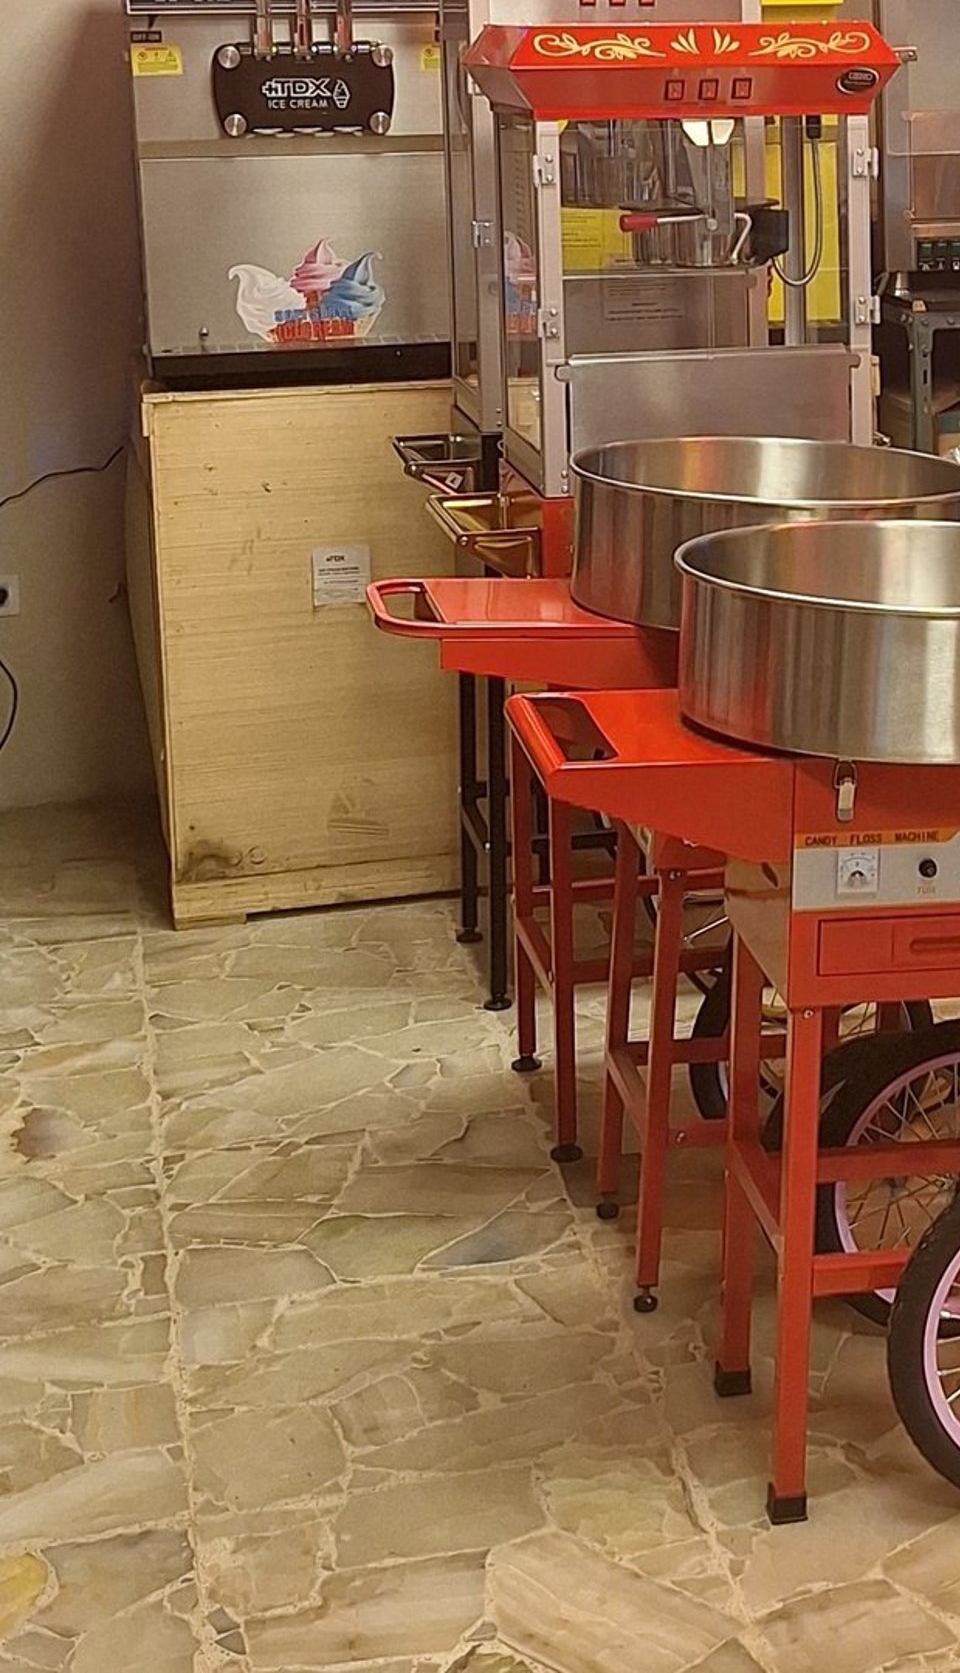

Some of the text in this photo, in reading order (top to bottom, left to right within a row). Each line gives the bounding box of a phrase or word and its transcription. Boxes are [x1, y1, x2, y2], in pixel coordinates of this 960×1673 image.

[268, 99, 328, 108] ICE CREAM
[805, 830, 940, 846] CANDY FLOSS MACHINE
